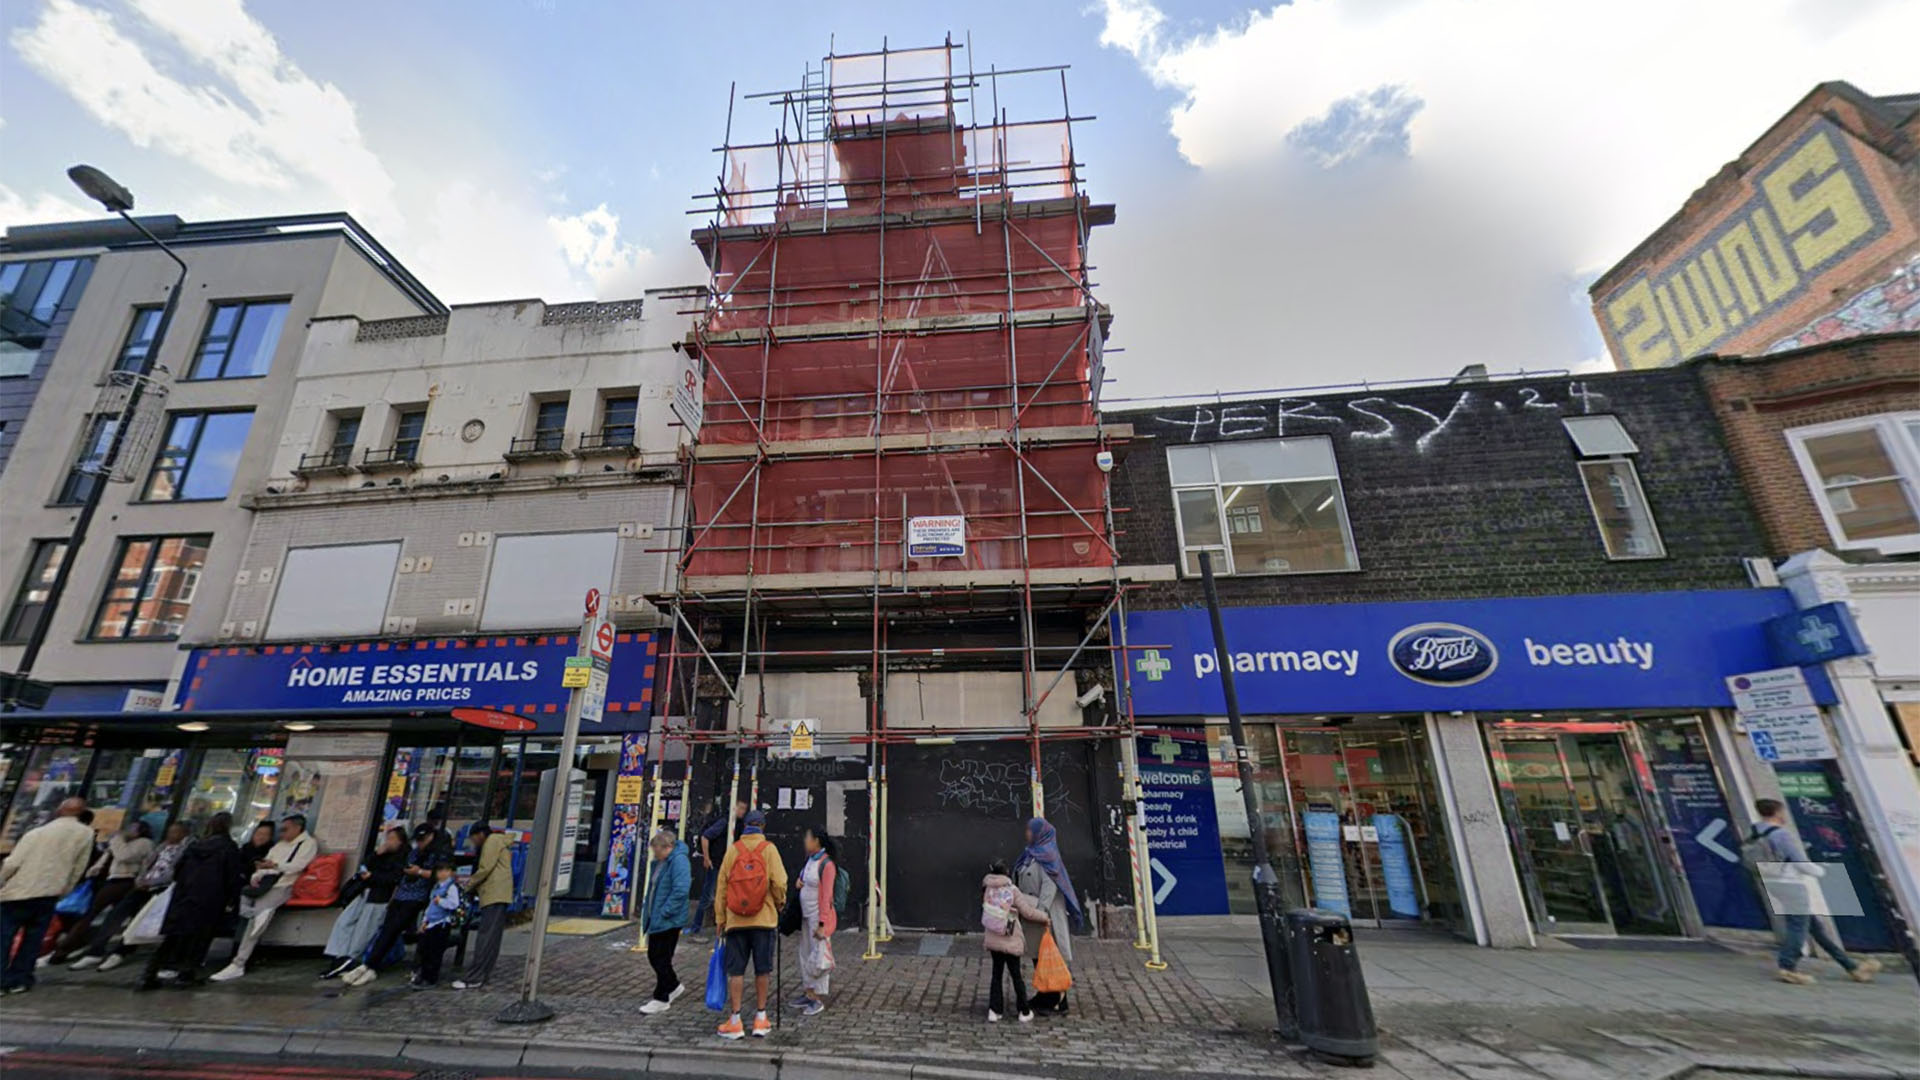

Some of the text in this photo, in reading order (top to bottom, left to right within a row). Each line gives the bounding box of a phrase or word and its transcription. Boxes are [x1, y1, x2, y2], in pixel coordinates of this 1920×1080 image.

[912, 519, 961, 528] WARNING!
[1408, 636, 1479, 671] Boots
[1524, 636, 1654, 670] beauty
[288, 660, 538, 687] HOME ESSENTIALS
[342, 687, 472, 702] AMAZING PRICES
[1140, 771, 1201, 785] welcome
[1143, 789, 1184, 800] pharmacy
[1166, 815, 1173, 823] &
[1175, 814, 1197, 823] drink
[1169, 827, 1176, 836] &
[1177, 826, 1199, 836] child
[1148, 840, 1187, 849] electrical
